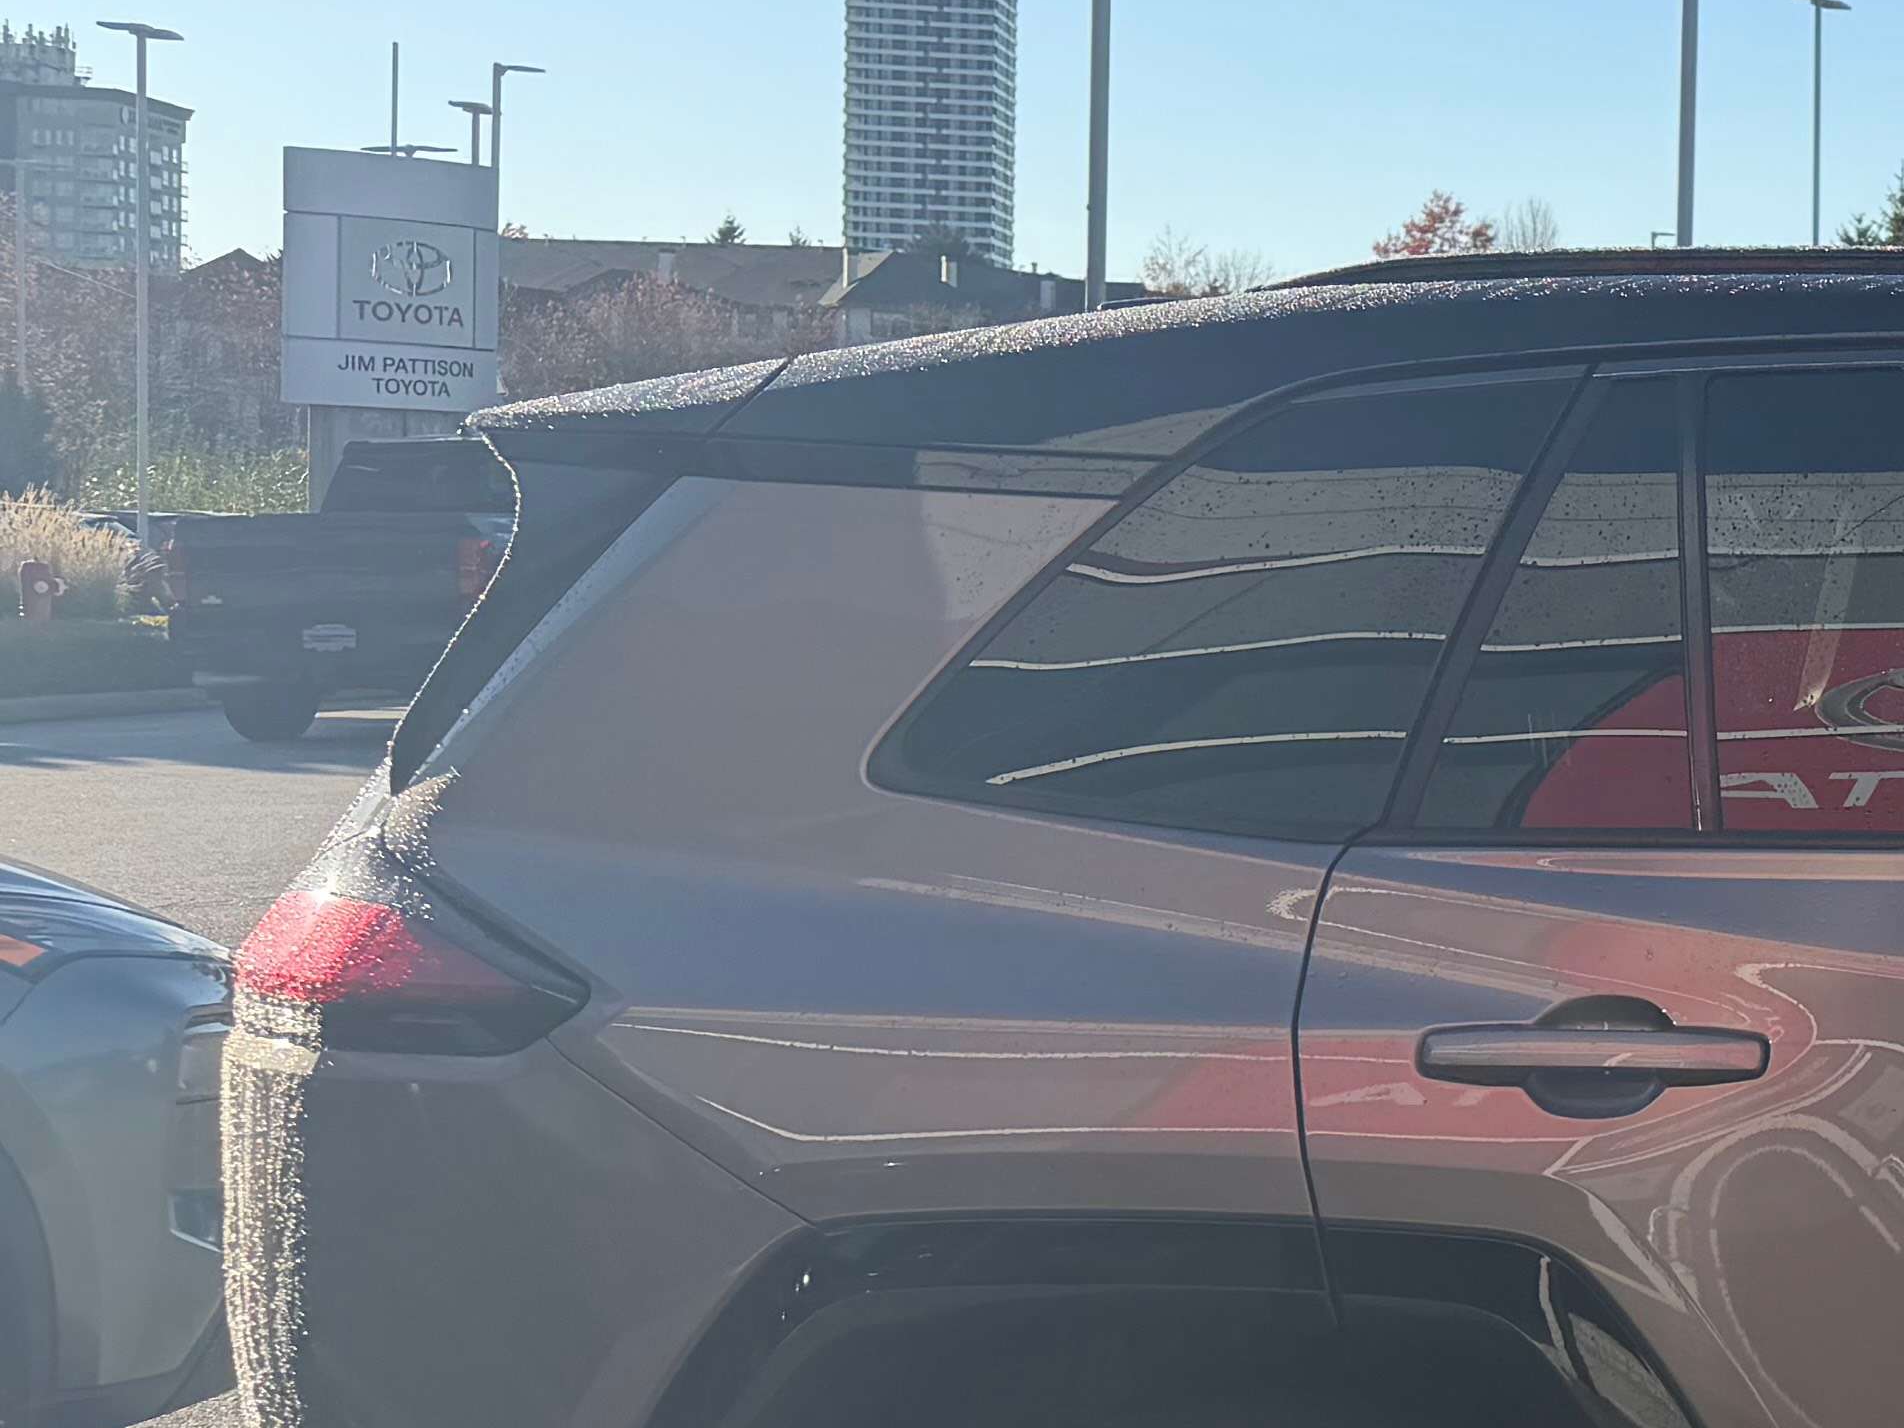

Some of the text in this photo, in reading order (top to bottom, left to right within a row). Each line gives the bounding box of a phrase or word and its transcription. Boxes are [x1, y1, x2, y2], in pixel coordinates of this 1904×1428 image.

[352, 300, 464, 327] TOYOTA
[337, 354, 474, 378] JIM PATTISON
[371, 378, 450, 397] TOYOTA
